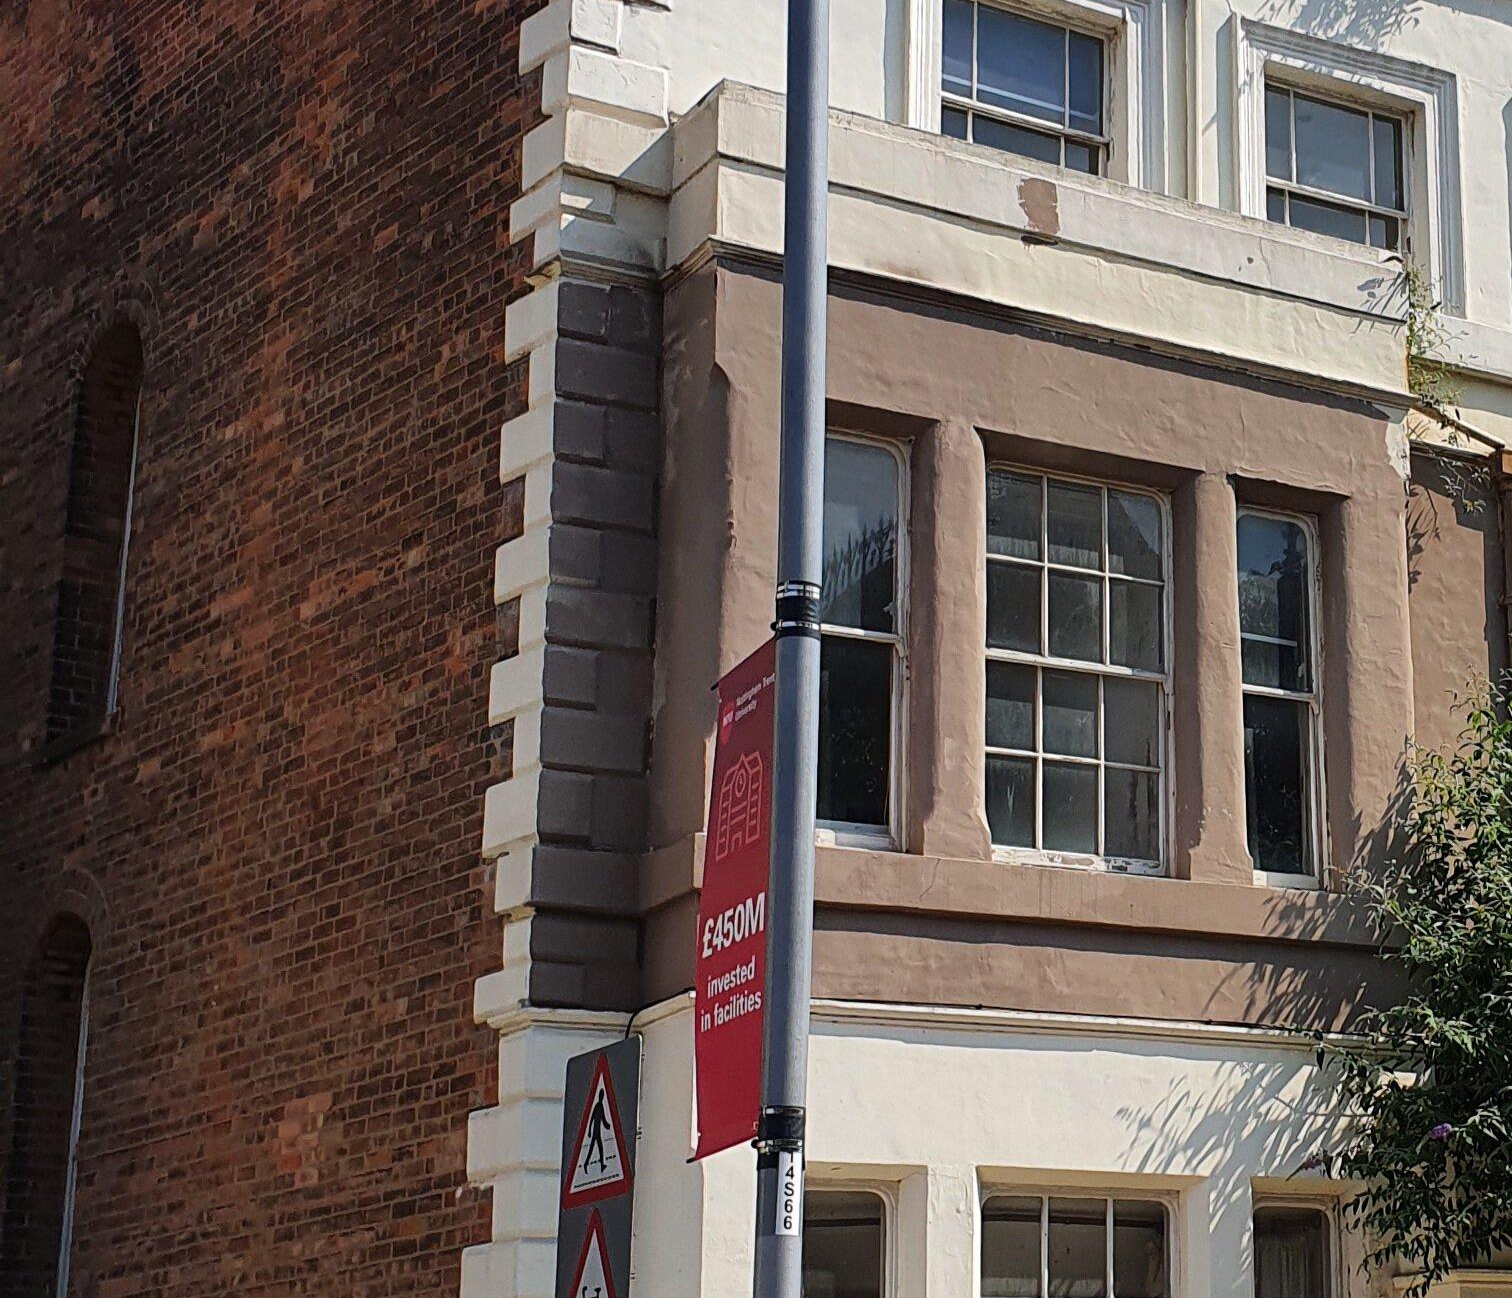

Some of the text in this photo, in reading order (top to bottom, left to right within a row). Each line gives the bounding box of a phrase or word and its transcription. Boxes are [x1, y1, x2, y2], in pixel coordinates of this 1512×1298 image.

[702, 891, 765, 959] £450M
[707, 954, 756, 999] invested
[701, 989, 761, 1033] in facilities
